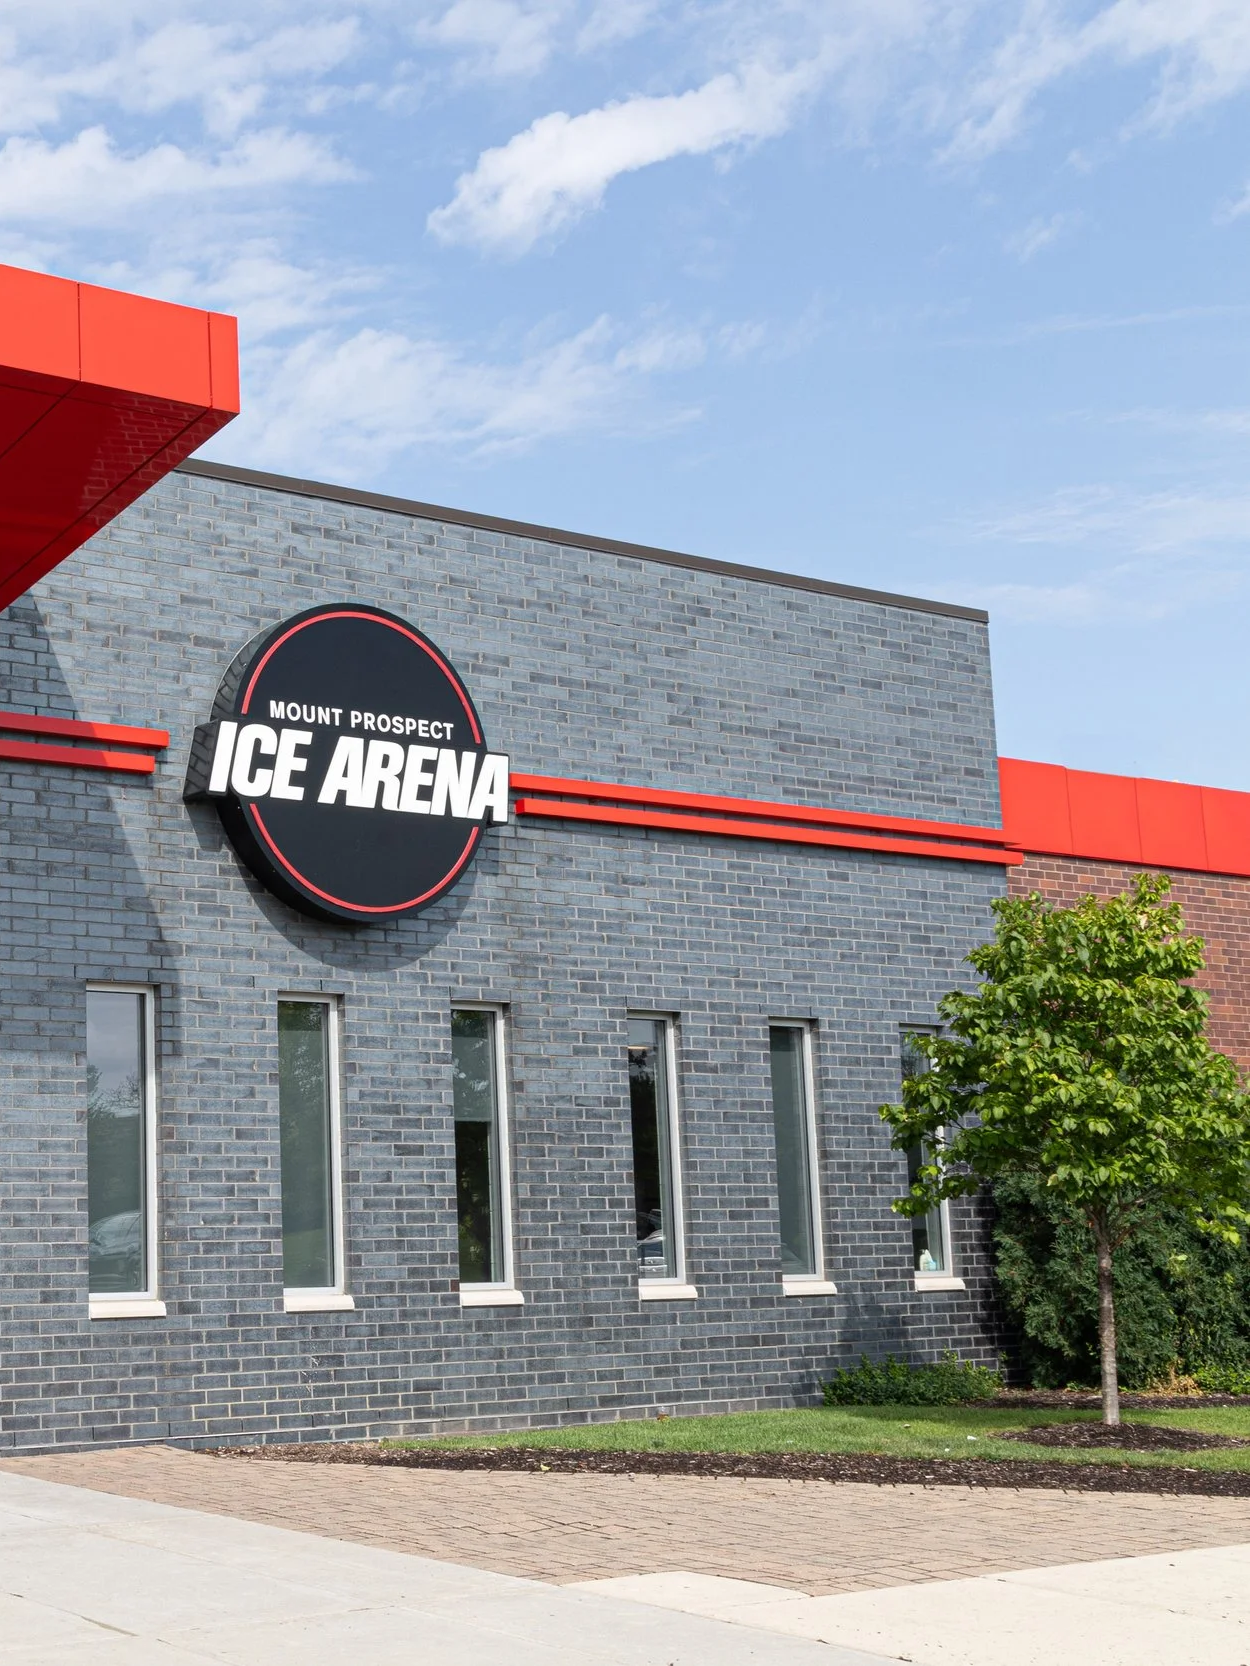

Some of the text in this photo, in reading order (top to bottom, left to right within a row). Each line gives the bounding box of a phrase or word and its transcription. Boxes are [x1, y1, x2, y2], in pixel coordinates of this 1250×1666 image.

[269, 699, 455, 741] MOUNT PROSPECT
[208, 720, 510, 823] ICE ARENA
